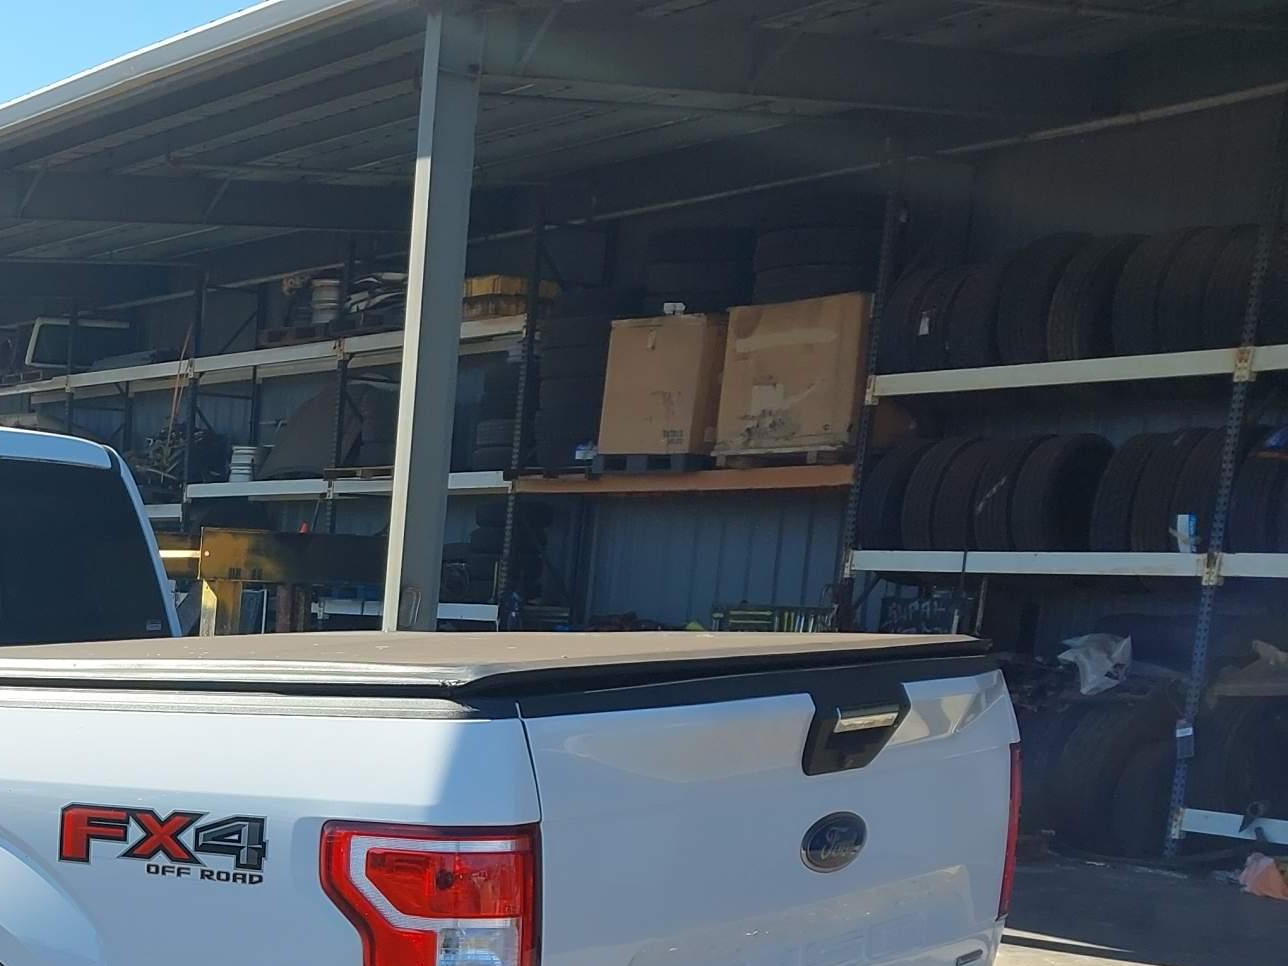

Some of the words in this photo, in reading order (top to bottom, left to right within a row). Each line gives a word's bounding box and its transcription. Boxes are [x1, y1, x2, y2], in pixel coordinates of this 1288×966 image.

[59, 803, 268, 872] FX4
[146, 863, 192, 878] OFF
[199, 868, 263, 885] ROAD
